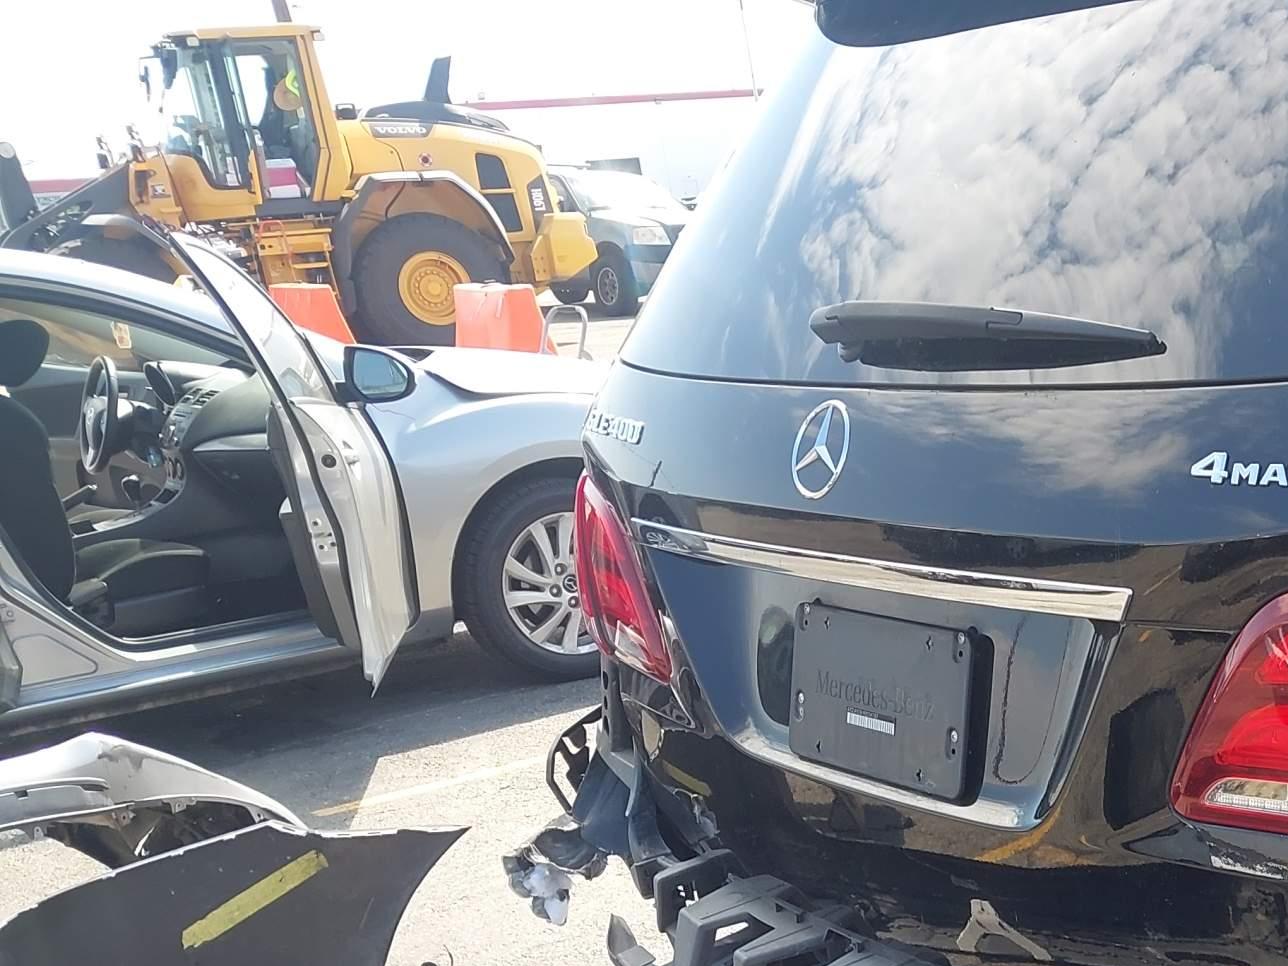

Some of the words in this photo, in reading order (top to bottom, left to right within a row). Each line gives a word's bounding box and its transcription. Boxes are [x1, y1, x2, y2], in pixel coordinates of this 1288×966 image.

[374, 126, 427, 134] VOLVO
[531, 188, 546, 211] L90H
[816, 669, 936, 720] Mercedes-Benz
